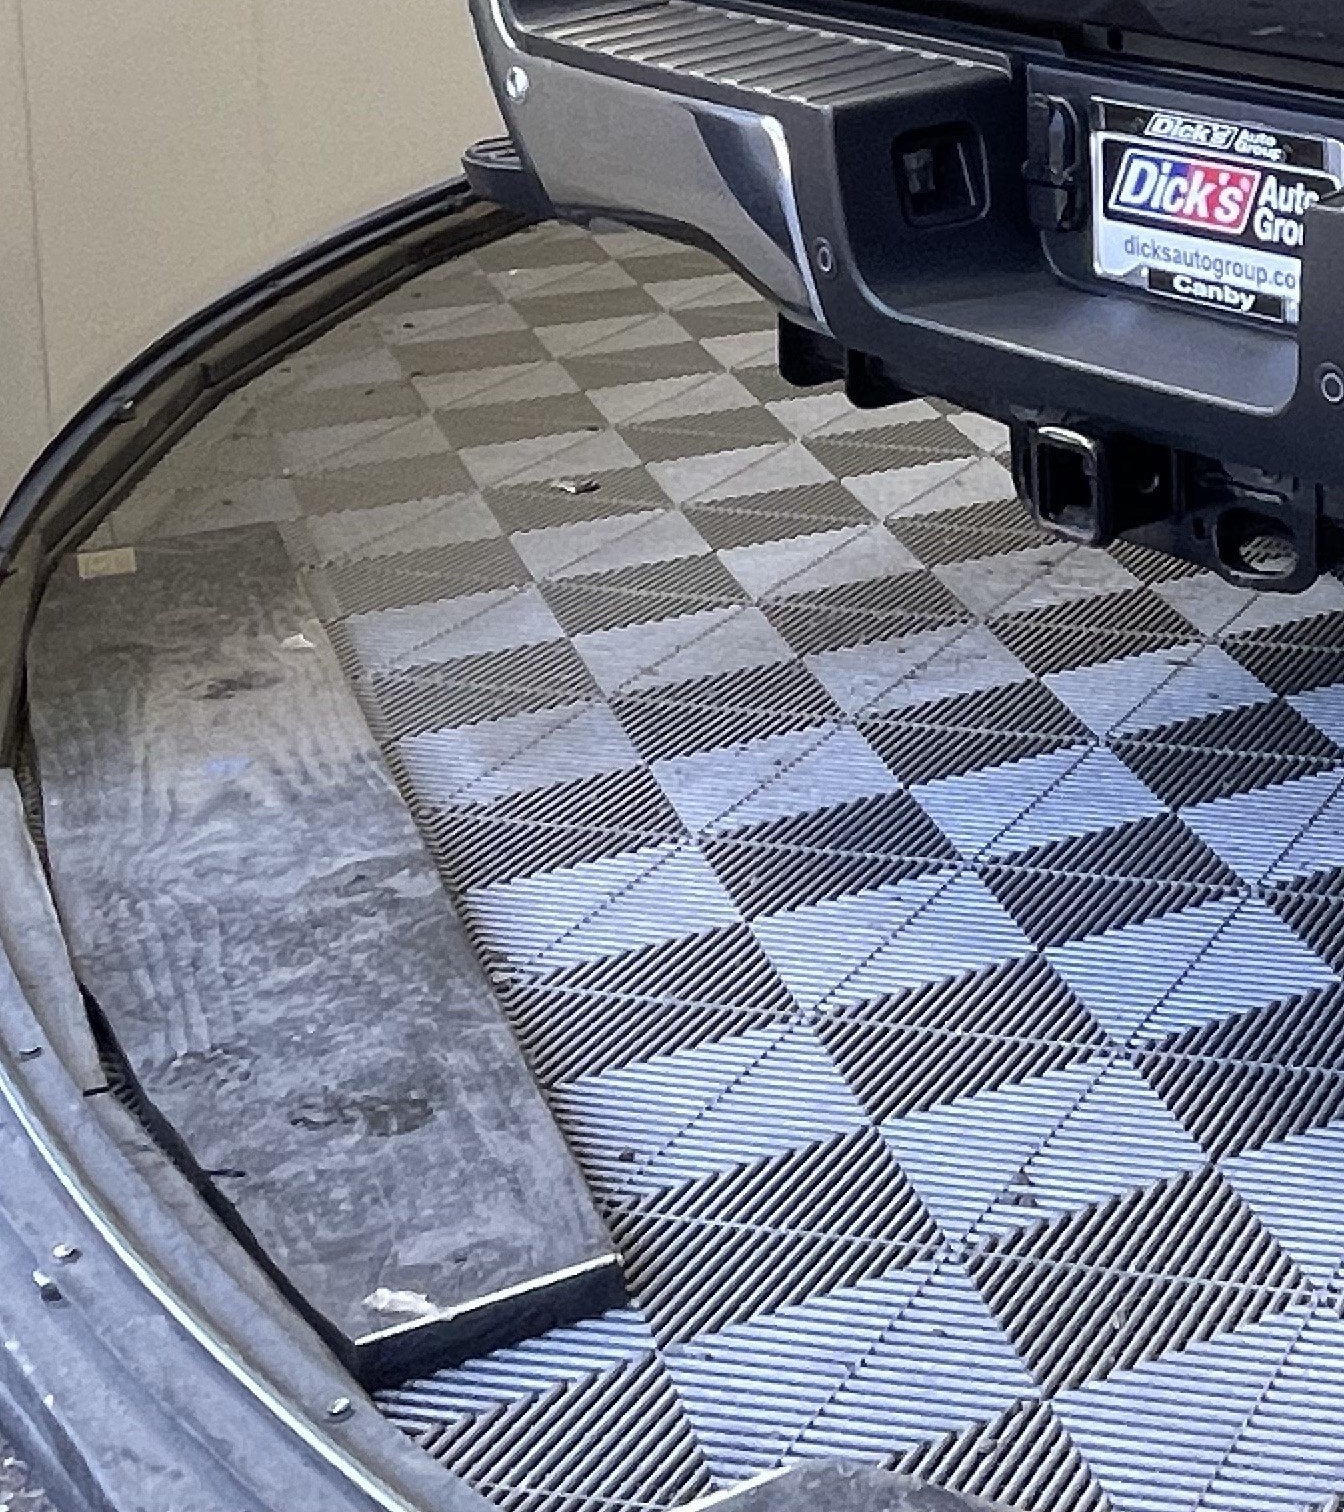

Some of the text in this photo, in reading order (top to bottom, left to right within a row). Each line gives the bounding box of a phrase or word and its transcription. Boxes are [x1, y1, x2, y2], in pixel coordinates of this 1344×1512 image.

[1149, 114, 1234, 148] Dick's
[1118, 157, 1246, 224] Dick's
[1172, 274, 1256, 312] Canby
